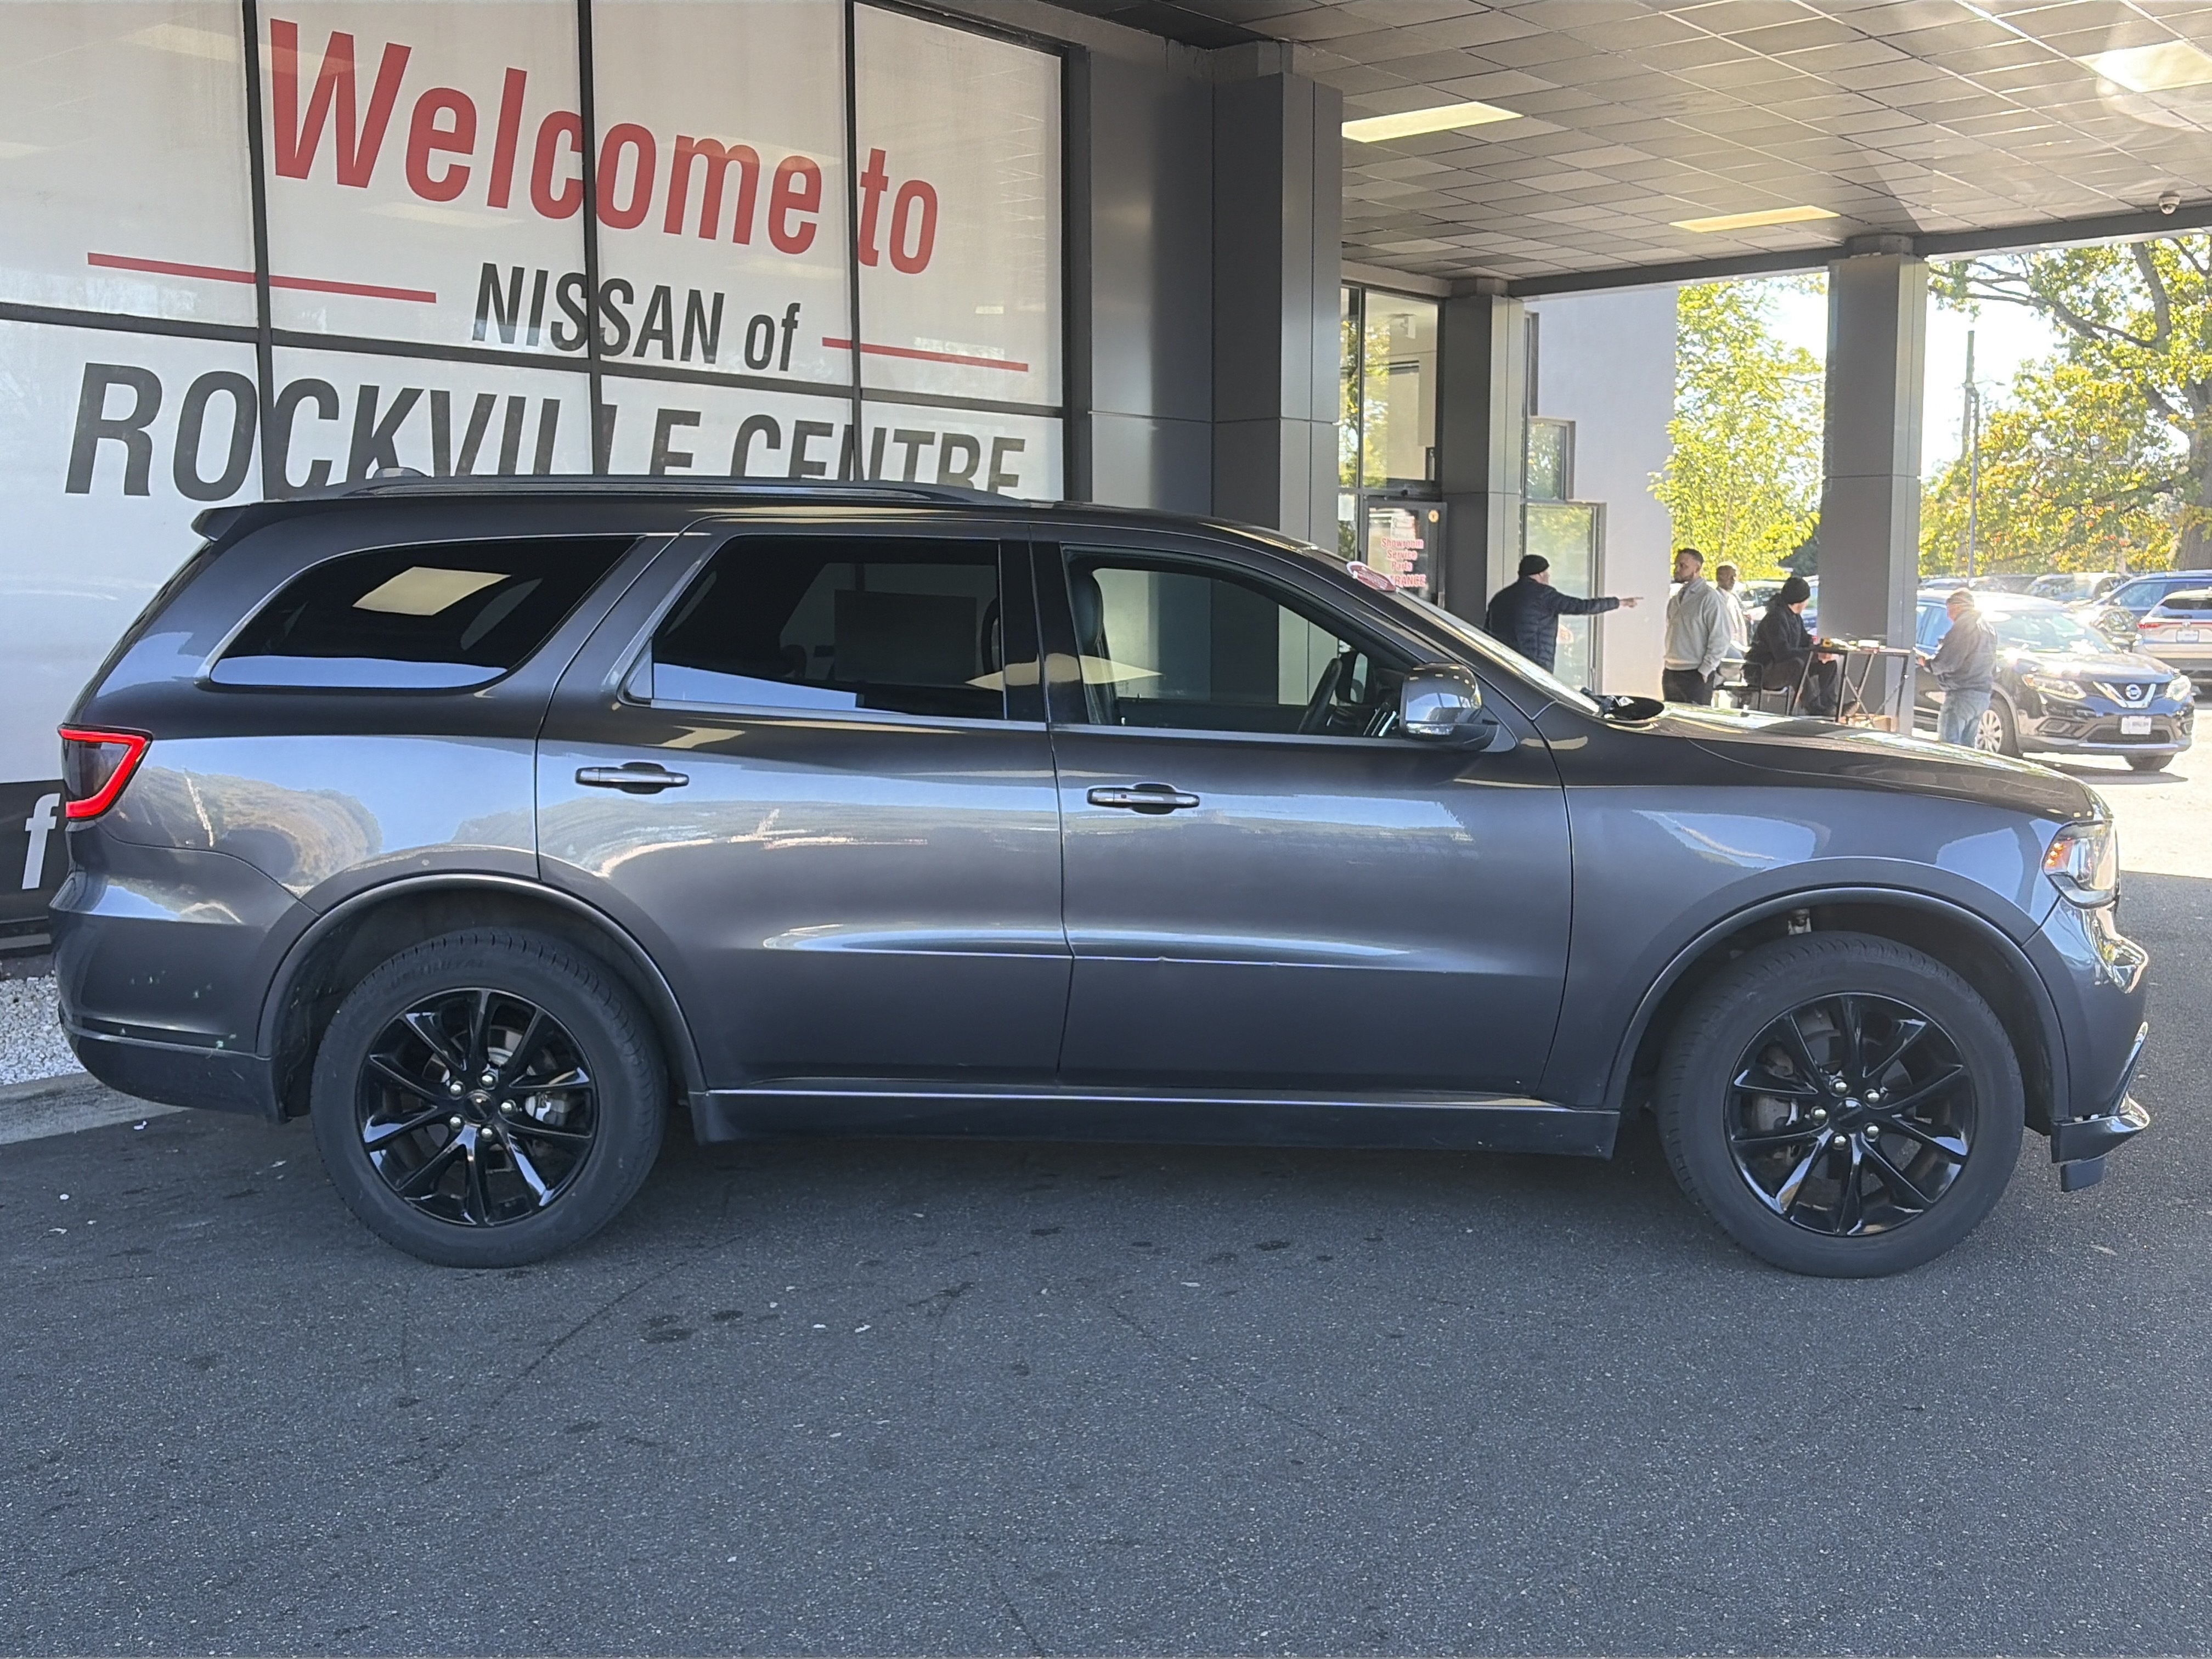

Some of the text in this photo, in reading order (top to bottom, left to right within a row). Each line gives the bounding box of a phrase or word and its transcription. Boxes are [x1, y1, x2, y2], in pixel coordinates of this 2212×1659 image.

[269, 18, 938, 274] Welcome to
[471, 262, 801, 371] NISSAN of
[1381, 538, 1424, 548] Showroom
[1387, 549, 1418, 560] Service
[1391, 561, 1413, 571] Parts
[22, 793, 60, 890] f
